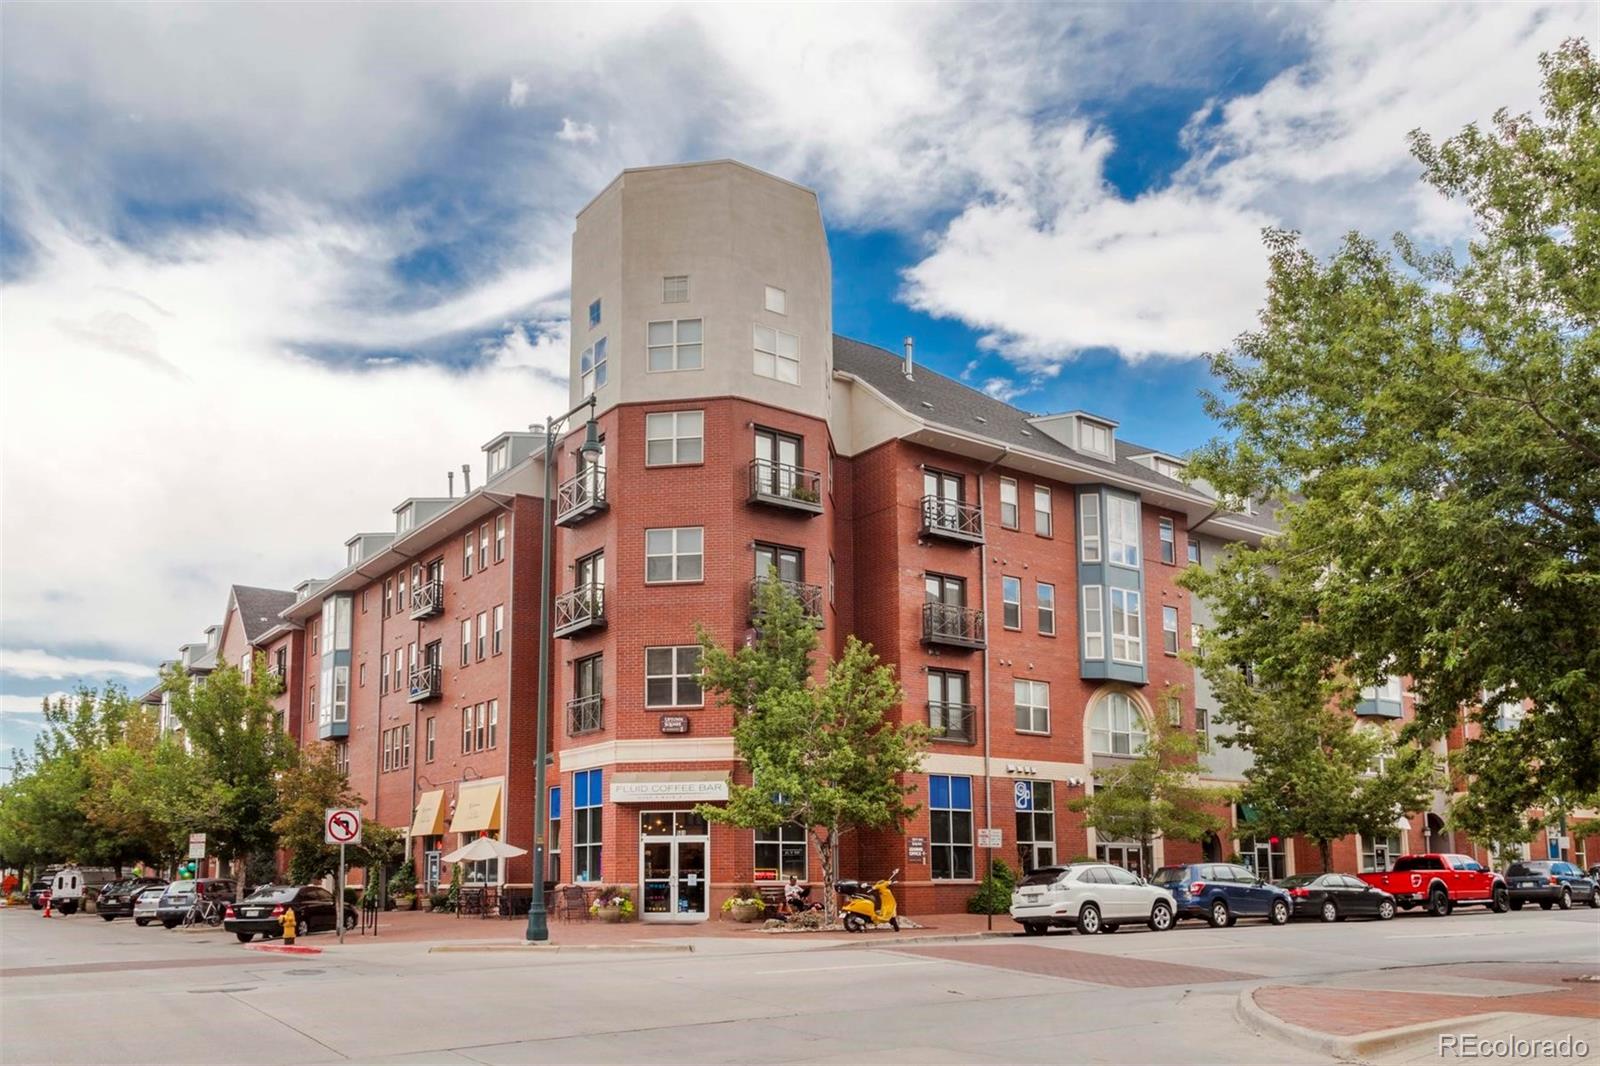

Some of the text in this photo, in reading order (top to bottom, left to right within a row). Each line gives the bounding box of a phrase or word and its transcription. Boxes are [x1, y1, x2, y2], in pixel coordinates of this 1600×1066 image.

[615, 783, 722, 793] FLUID COFFEE BAR
